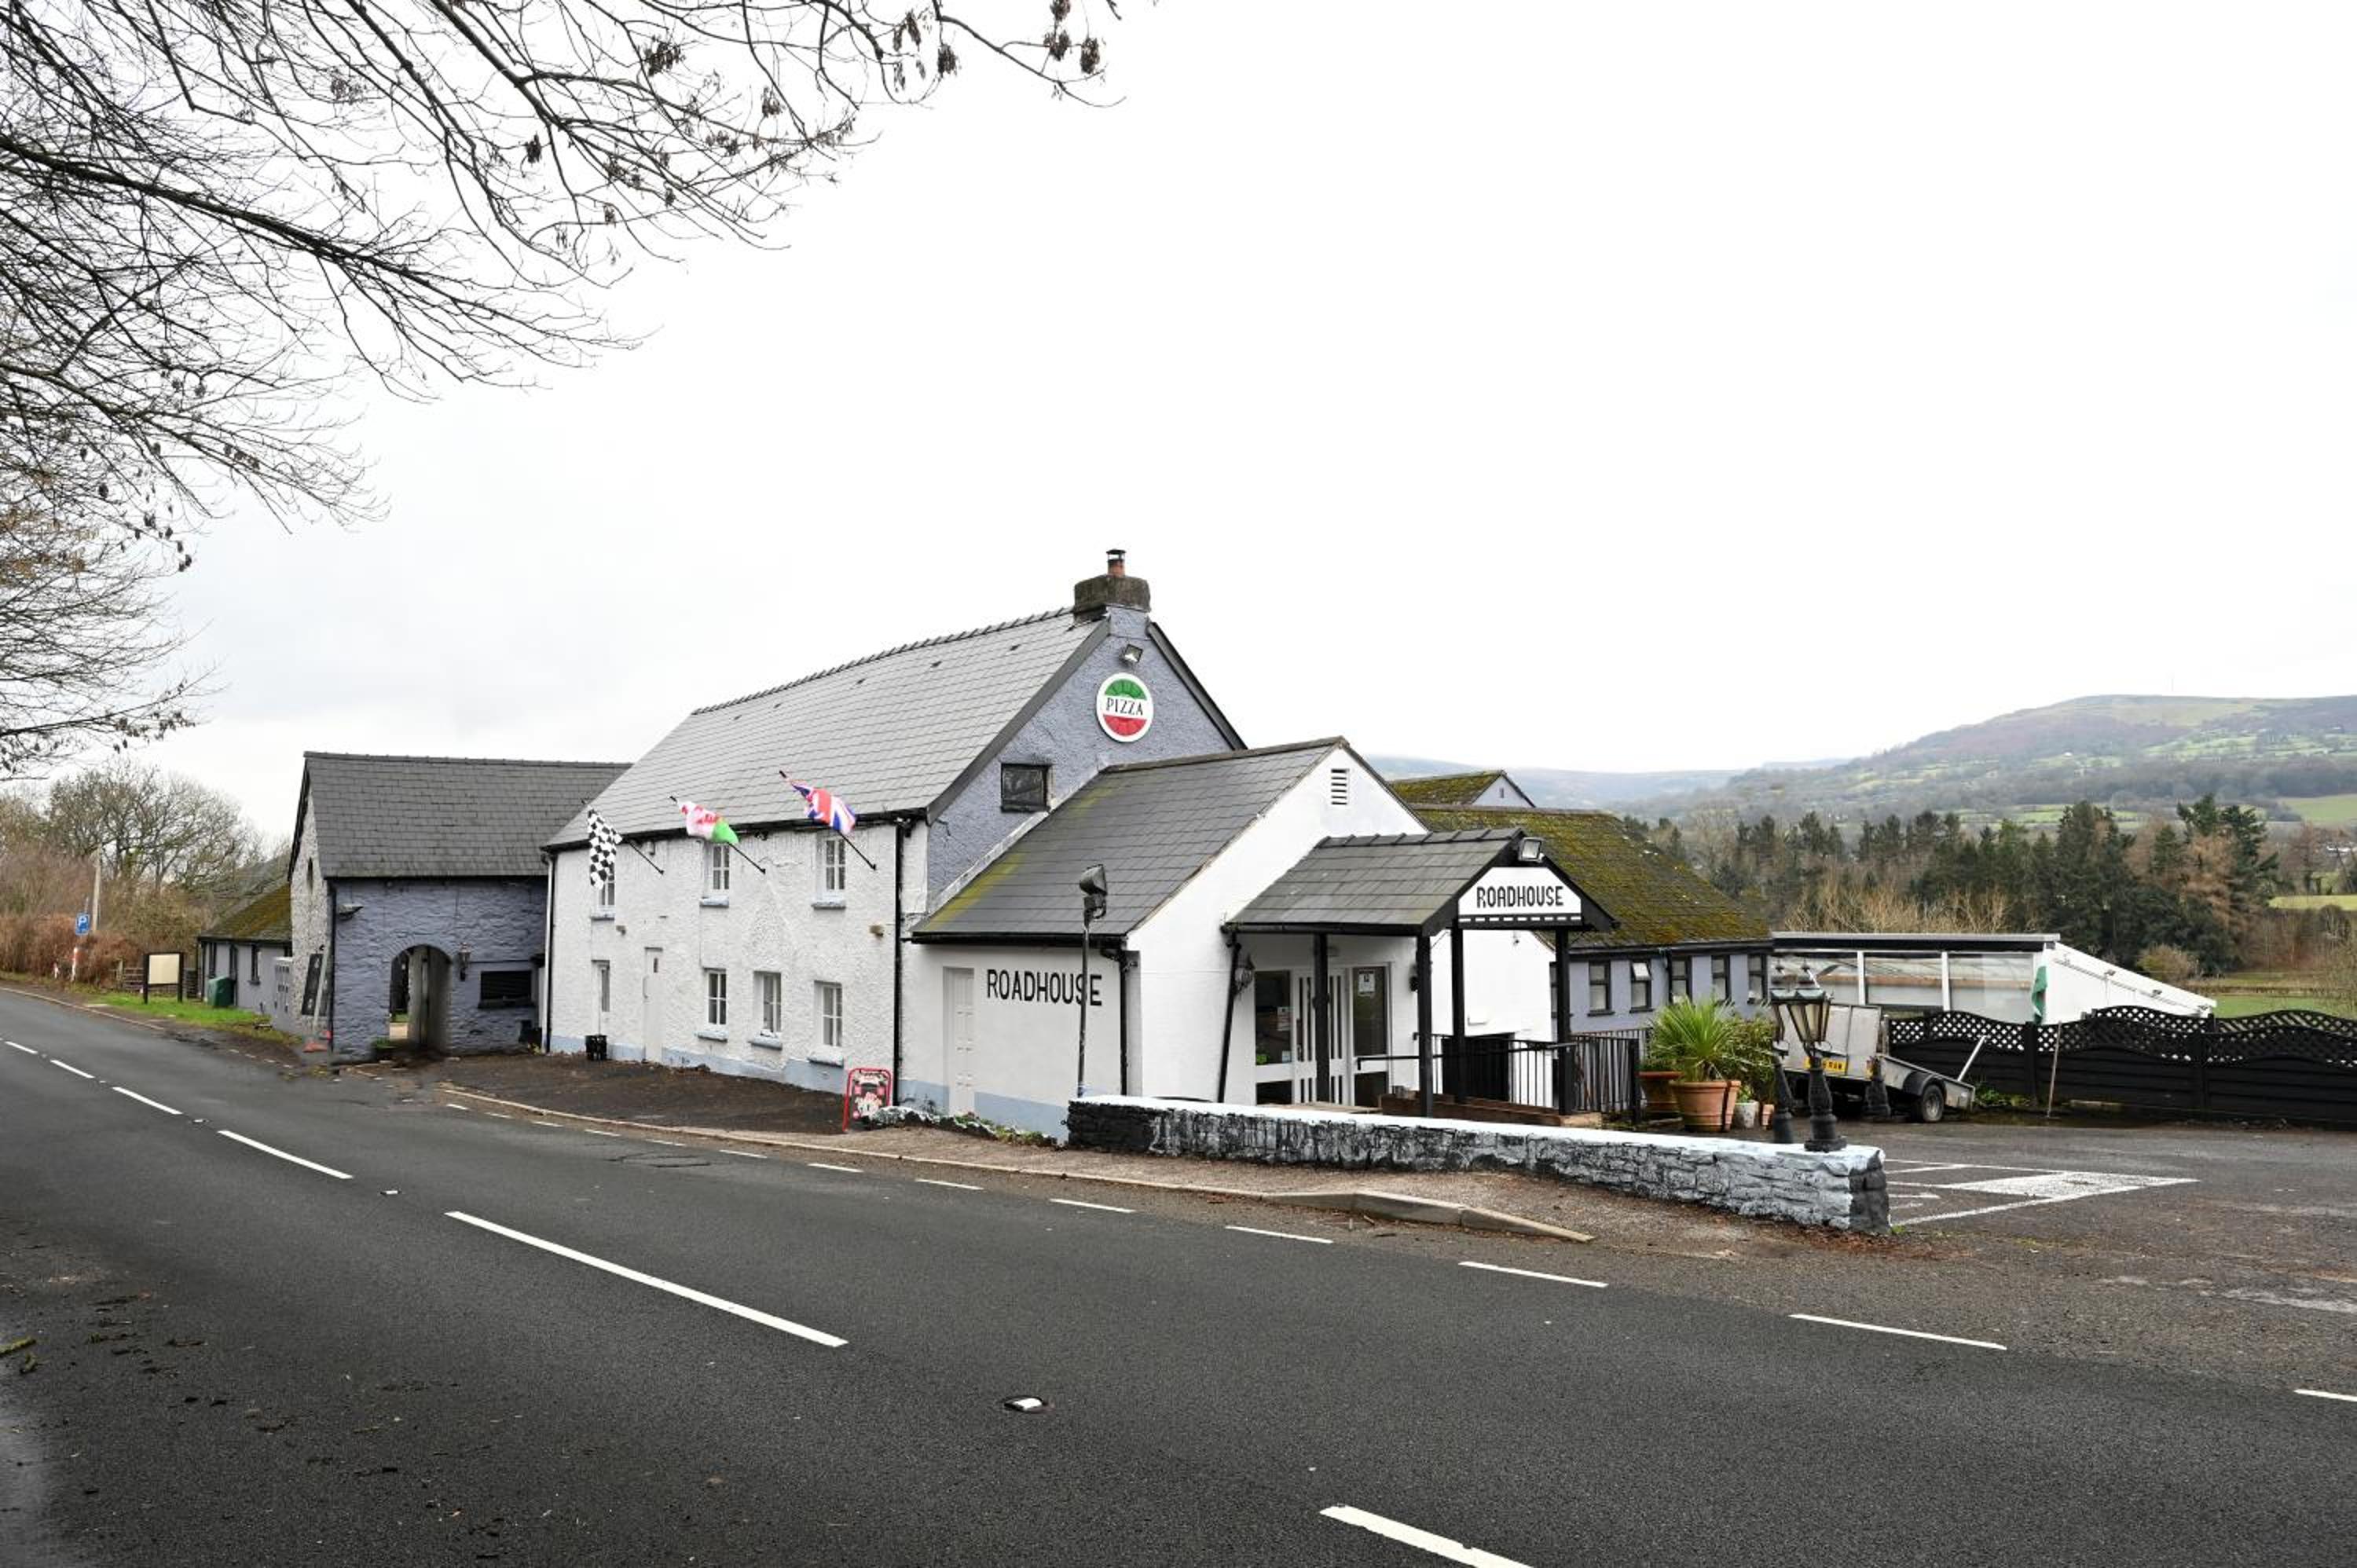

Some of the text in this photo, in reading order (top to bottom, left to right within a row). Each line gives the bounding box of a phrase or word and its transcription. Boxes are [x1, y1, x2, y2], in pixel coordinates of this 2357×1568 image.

[1106, 698, 1142, 716] PIZZA
[1477, 886, 1563, 908] ROADHOUSE
[78, 916, 87, 929] P
